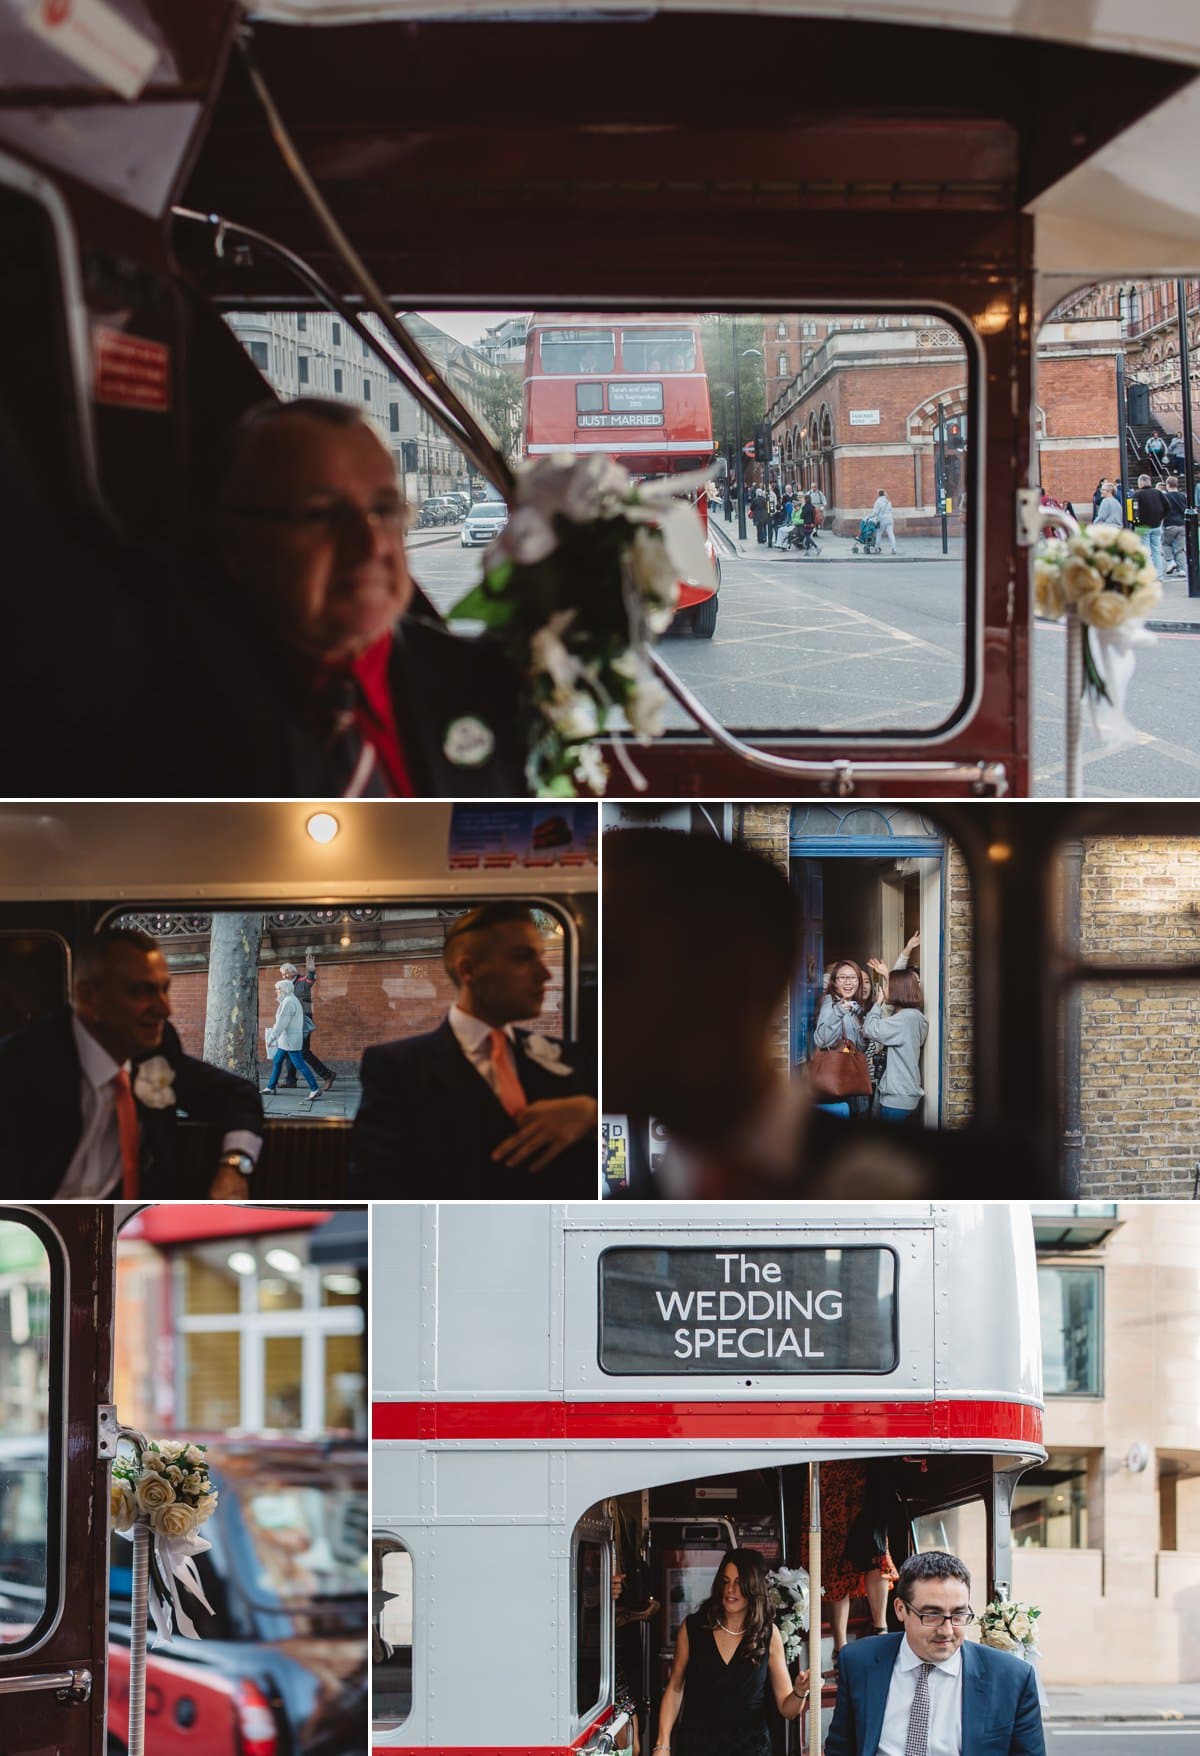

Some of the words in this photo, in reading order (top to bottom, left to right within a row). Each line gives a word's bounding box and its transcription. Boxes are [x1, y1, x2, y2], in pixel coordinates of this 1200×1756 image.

[580, 416, 607, 426] JUST
[611, 415, 661, 425] MARRIED
[715, 1253, 782, 1284] The
[655, 1290, 843, 1321] WEDDING
[673, 1327, 825, 1359] SPECIAL
